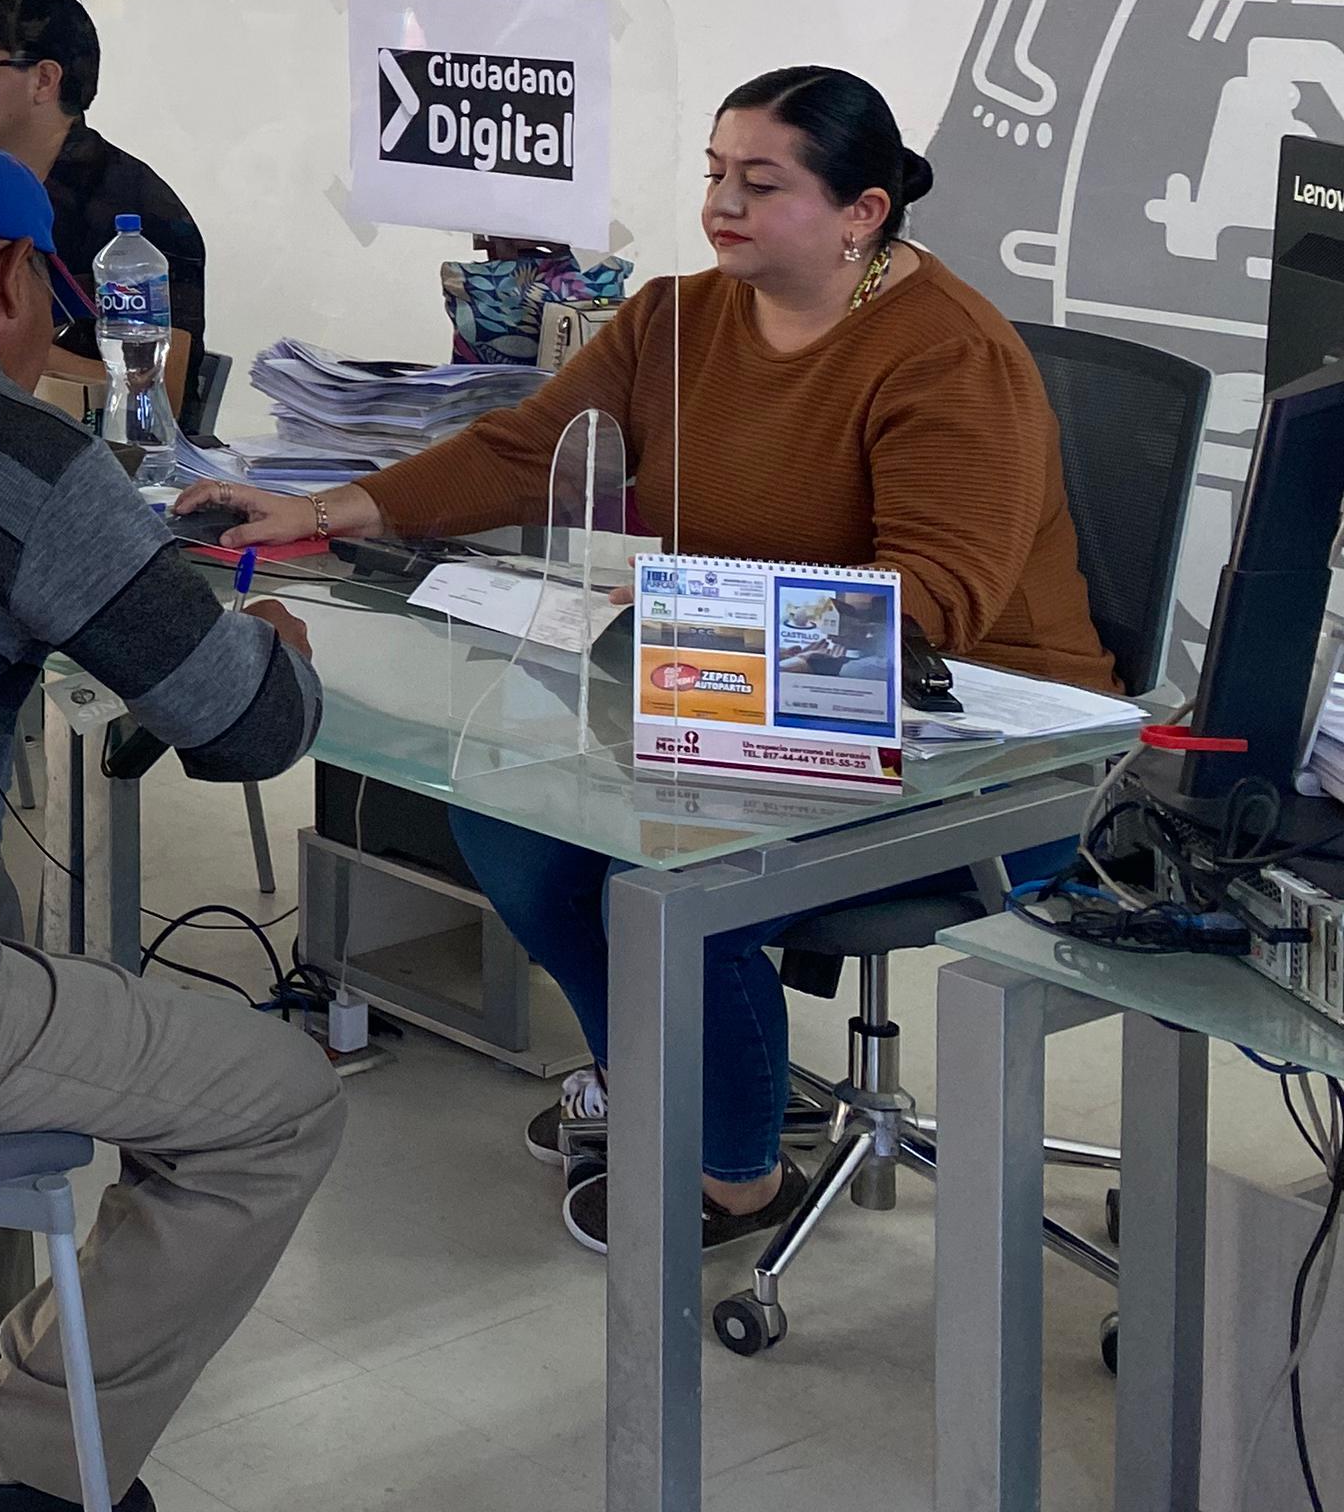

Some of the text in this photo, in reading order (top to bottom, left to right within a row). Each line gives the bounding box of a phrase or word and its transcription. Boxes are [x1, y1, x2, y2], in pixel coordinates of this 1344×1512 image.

[427, 52, 574, 97] Ciudadano
[428, 99, 573, 172] Digital
[694, 681, 752, 694] AUTOPARTES
[701, 671, 746, 684] ZEPEDA
